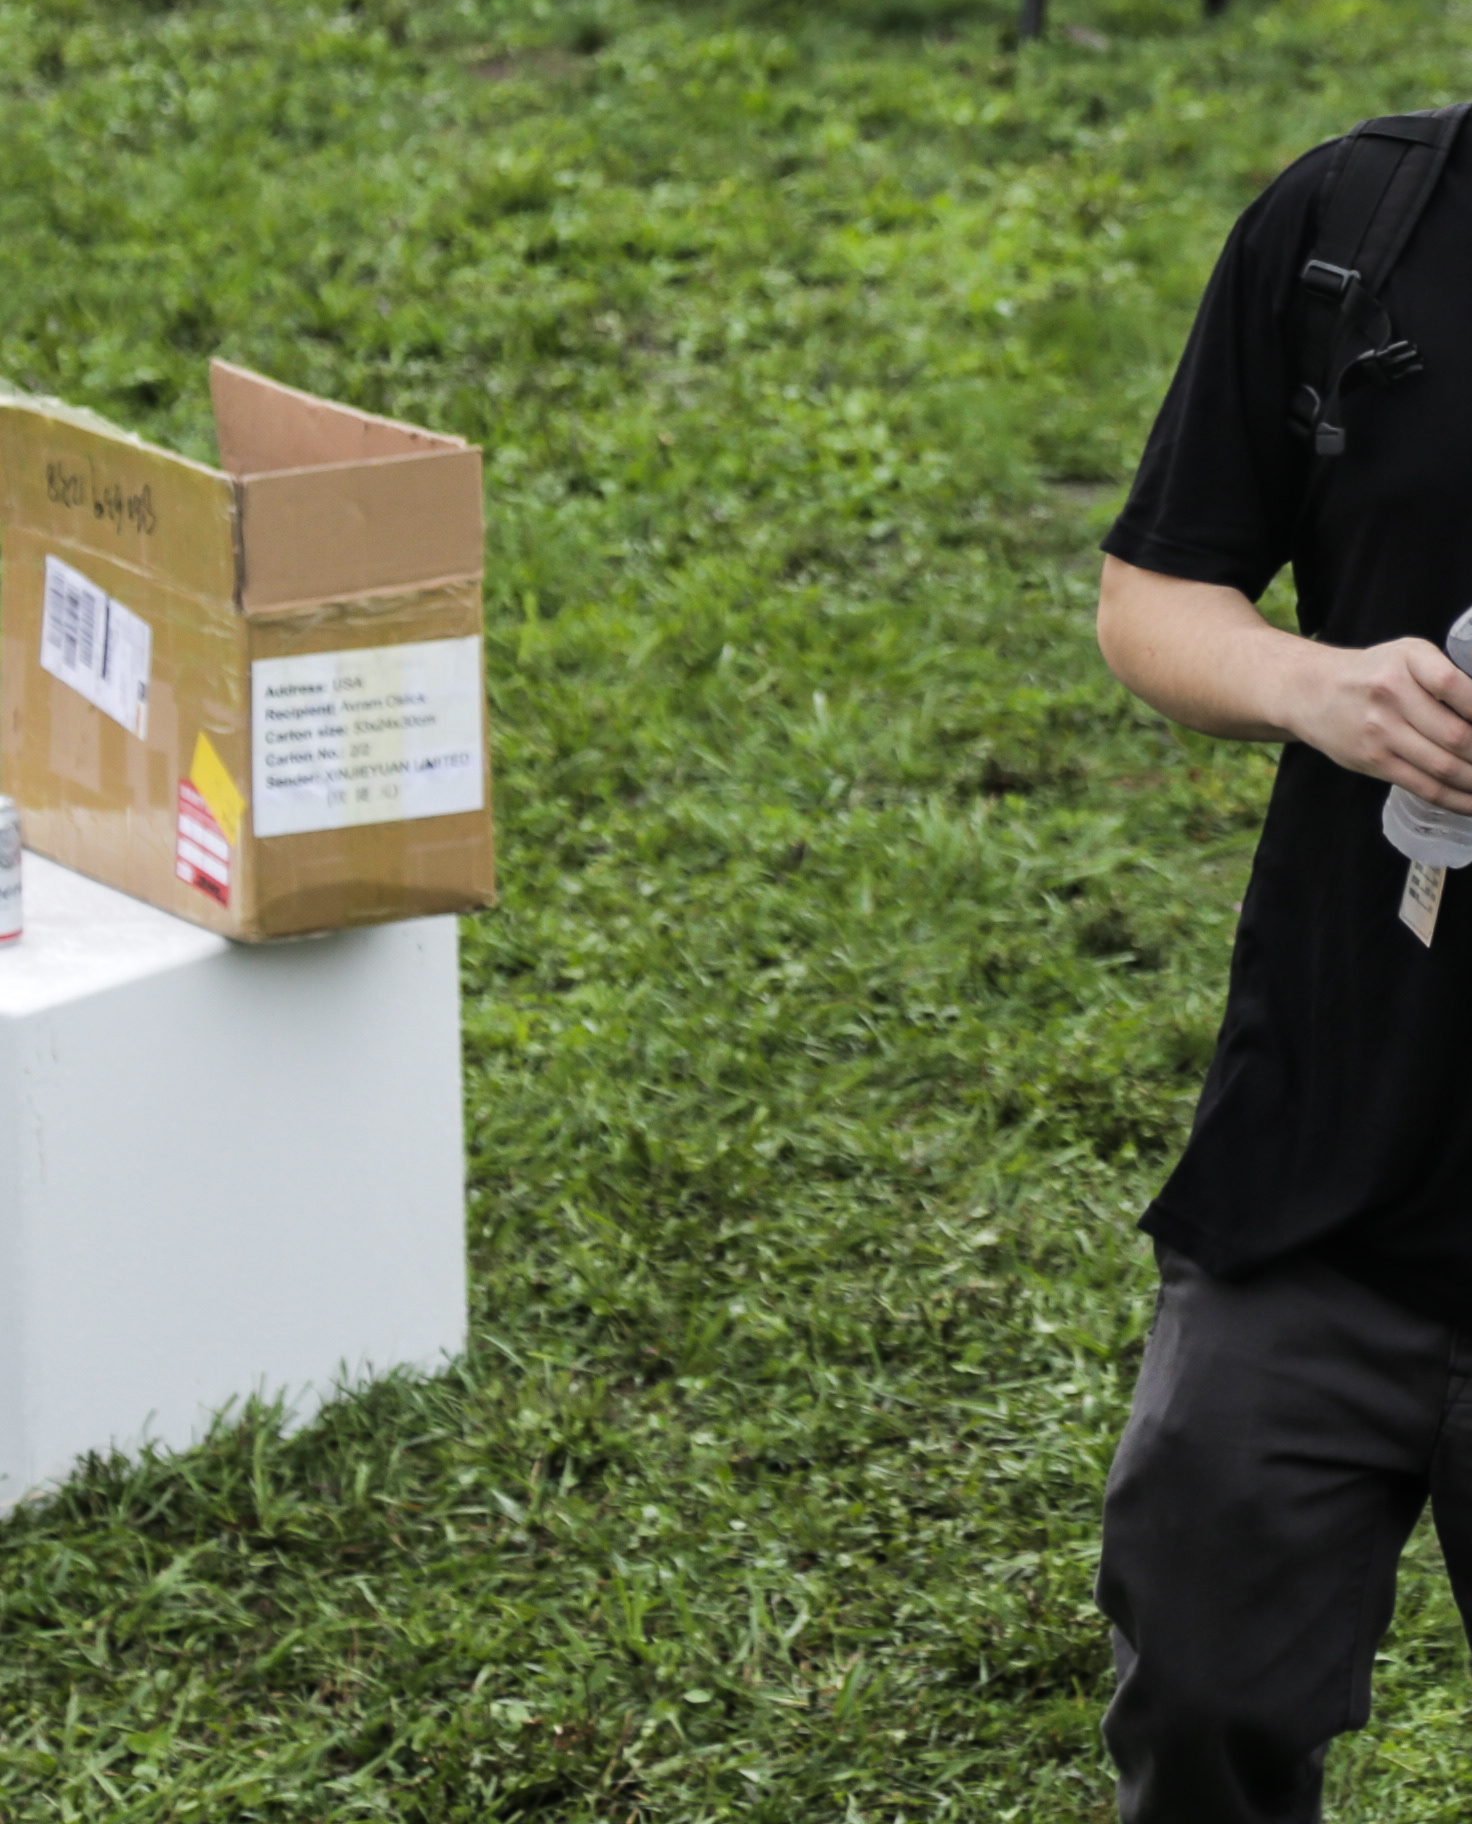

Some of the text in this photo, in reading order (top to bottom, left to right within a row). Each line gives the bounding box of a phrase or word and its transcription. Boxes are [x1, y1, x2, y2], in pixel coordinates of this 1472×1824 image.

[265, 676, 364, 698] Address: USA
[265, 729, 312, 744] Carton
[265, 752, 313, 768] Carton
